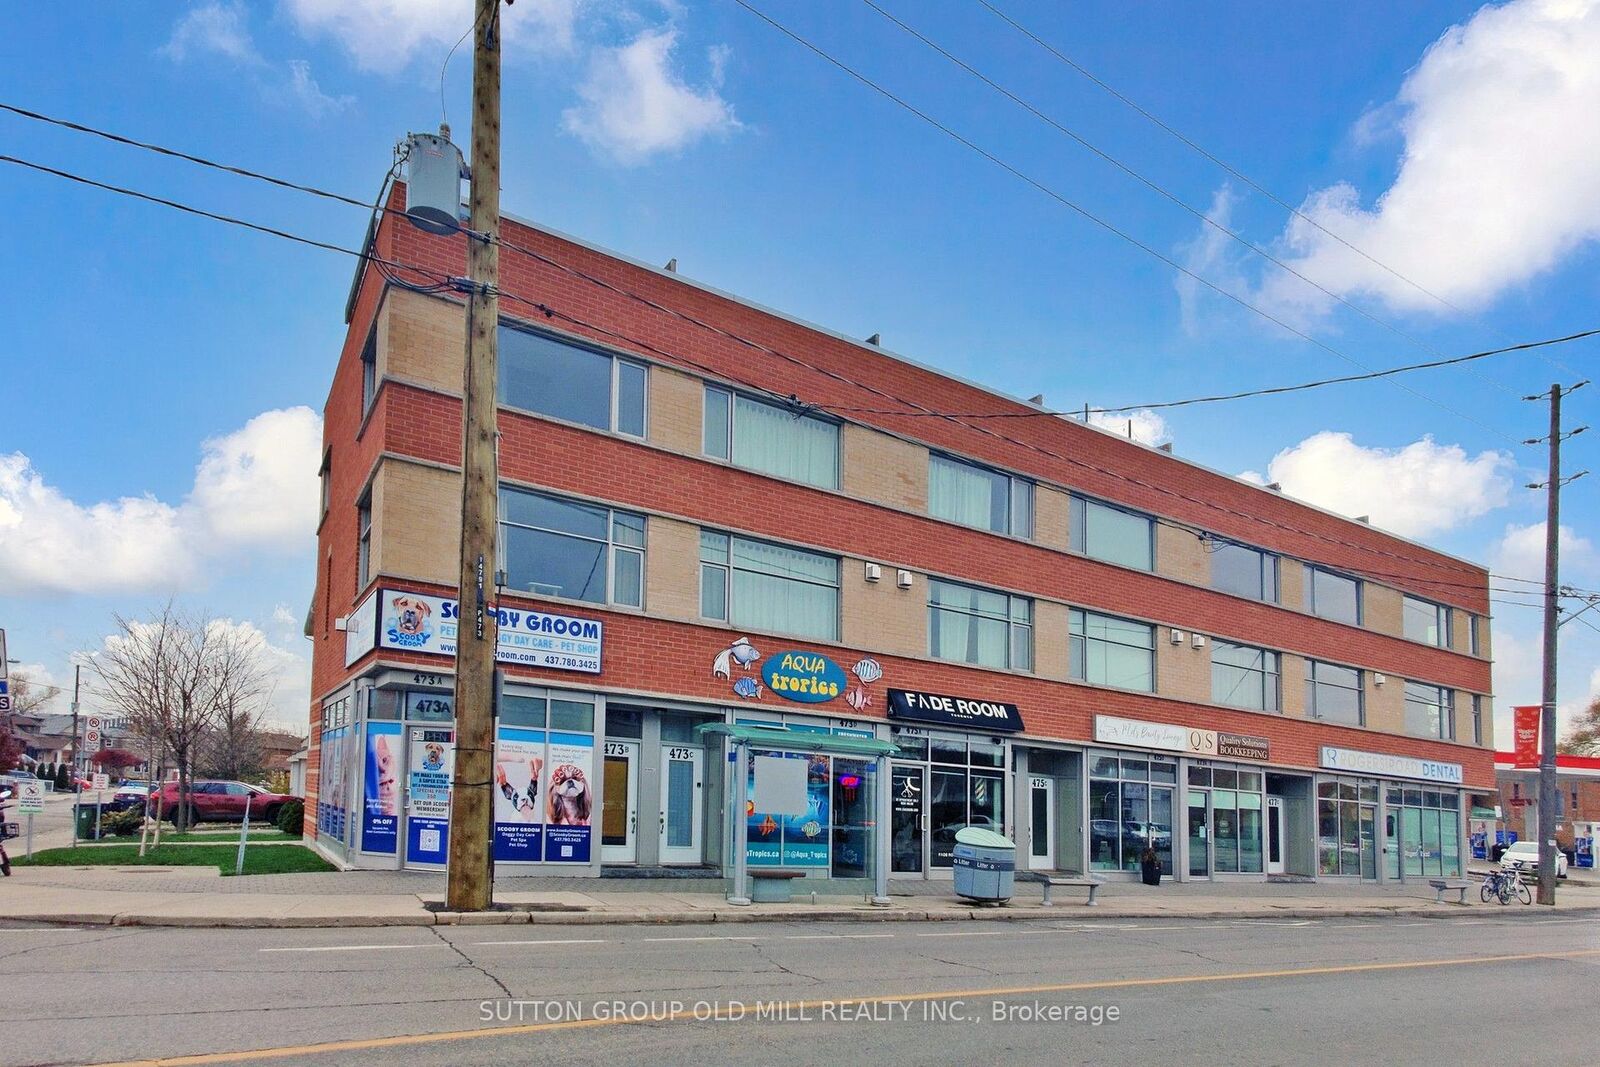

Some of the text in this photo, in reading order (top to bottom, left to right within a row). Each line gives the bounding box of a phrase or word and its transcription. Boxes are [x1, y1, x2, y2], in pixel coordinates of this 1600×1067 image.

[526, 614, 598, 639] GROOM
[441, 626, 456, 636] PET
[514, 634, 530, 645] DAY
[532, 637, 553, 649] CARE
[561, 641, 575, 651] PET
[577, 644, 598, 655] SHOP
[545, 655, 598, 670] 437.780.3425
[781, 653, 826, 675] AQUA
[771, 672, 838, 697] tropics
[416, 700, 451, 713] 473A
[956, 699, 1009, 719] ROOM
[1190, 731, 1213, 750] Q S
[1220, 734, 1268, 749] Quality Solutions
[1220, 745, 1267, 760] BOOKKEEPING
[1422, 762, 1460, 781] DENTAL
